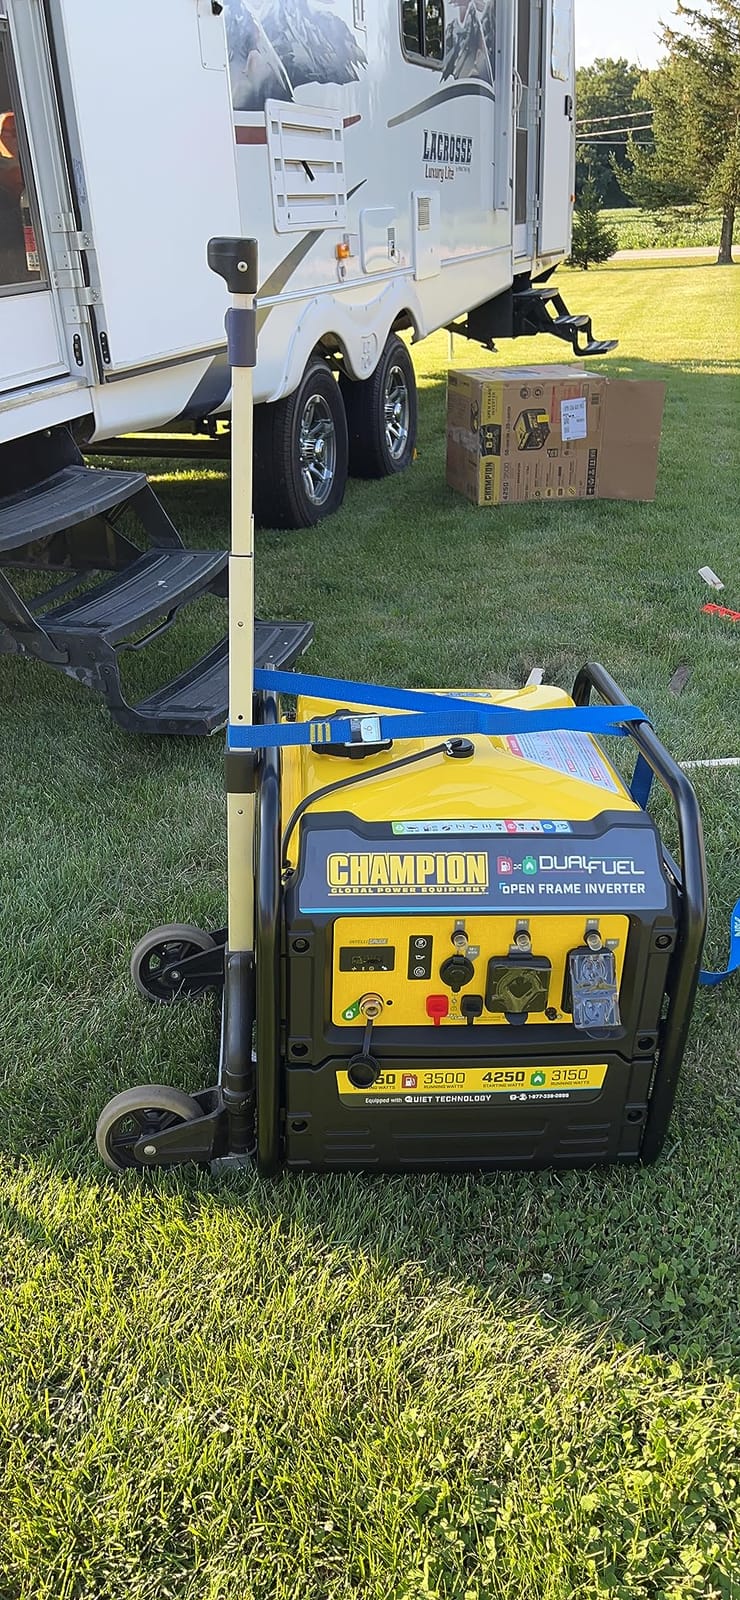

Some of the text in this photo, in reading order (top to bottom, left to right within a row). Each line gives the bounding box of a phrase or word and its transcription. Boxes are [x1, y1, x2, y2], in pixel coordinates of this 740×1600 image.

[423, 130, 472, 163] LACROSSE
[425, 163, 444, 183] Luxury
[444, 166, 454, 180] Lite
[484, 462, 493, 501] CHAMPION
[328, 853, 488, 886] CHAMPION
[538, 883, 581, 894] FRAME
[585, 883, 646, 894] INVERTER
[423, 1072, 466, 1084] 3500
[482, 1071, 525, 1083] 4250
[551, 1069, 588, 1081] 3150
[405, 1095, 432, 1103] QUIET
[435, 1094, 492, 1102] TECHNOLOGY
